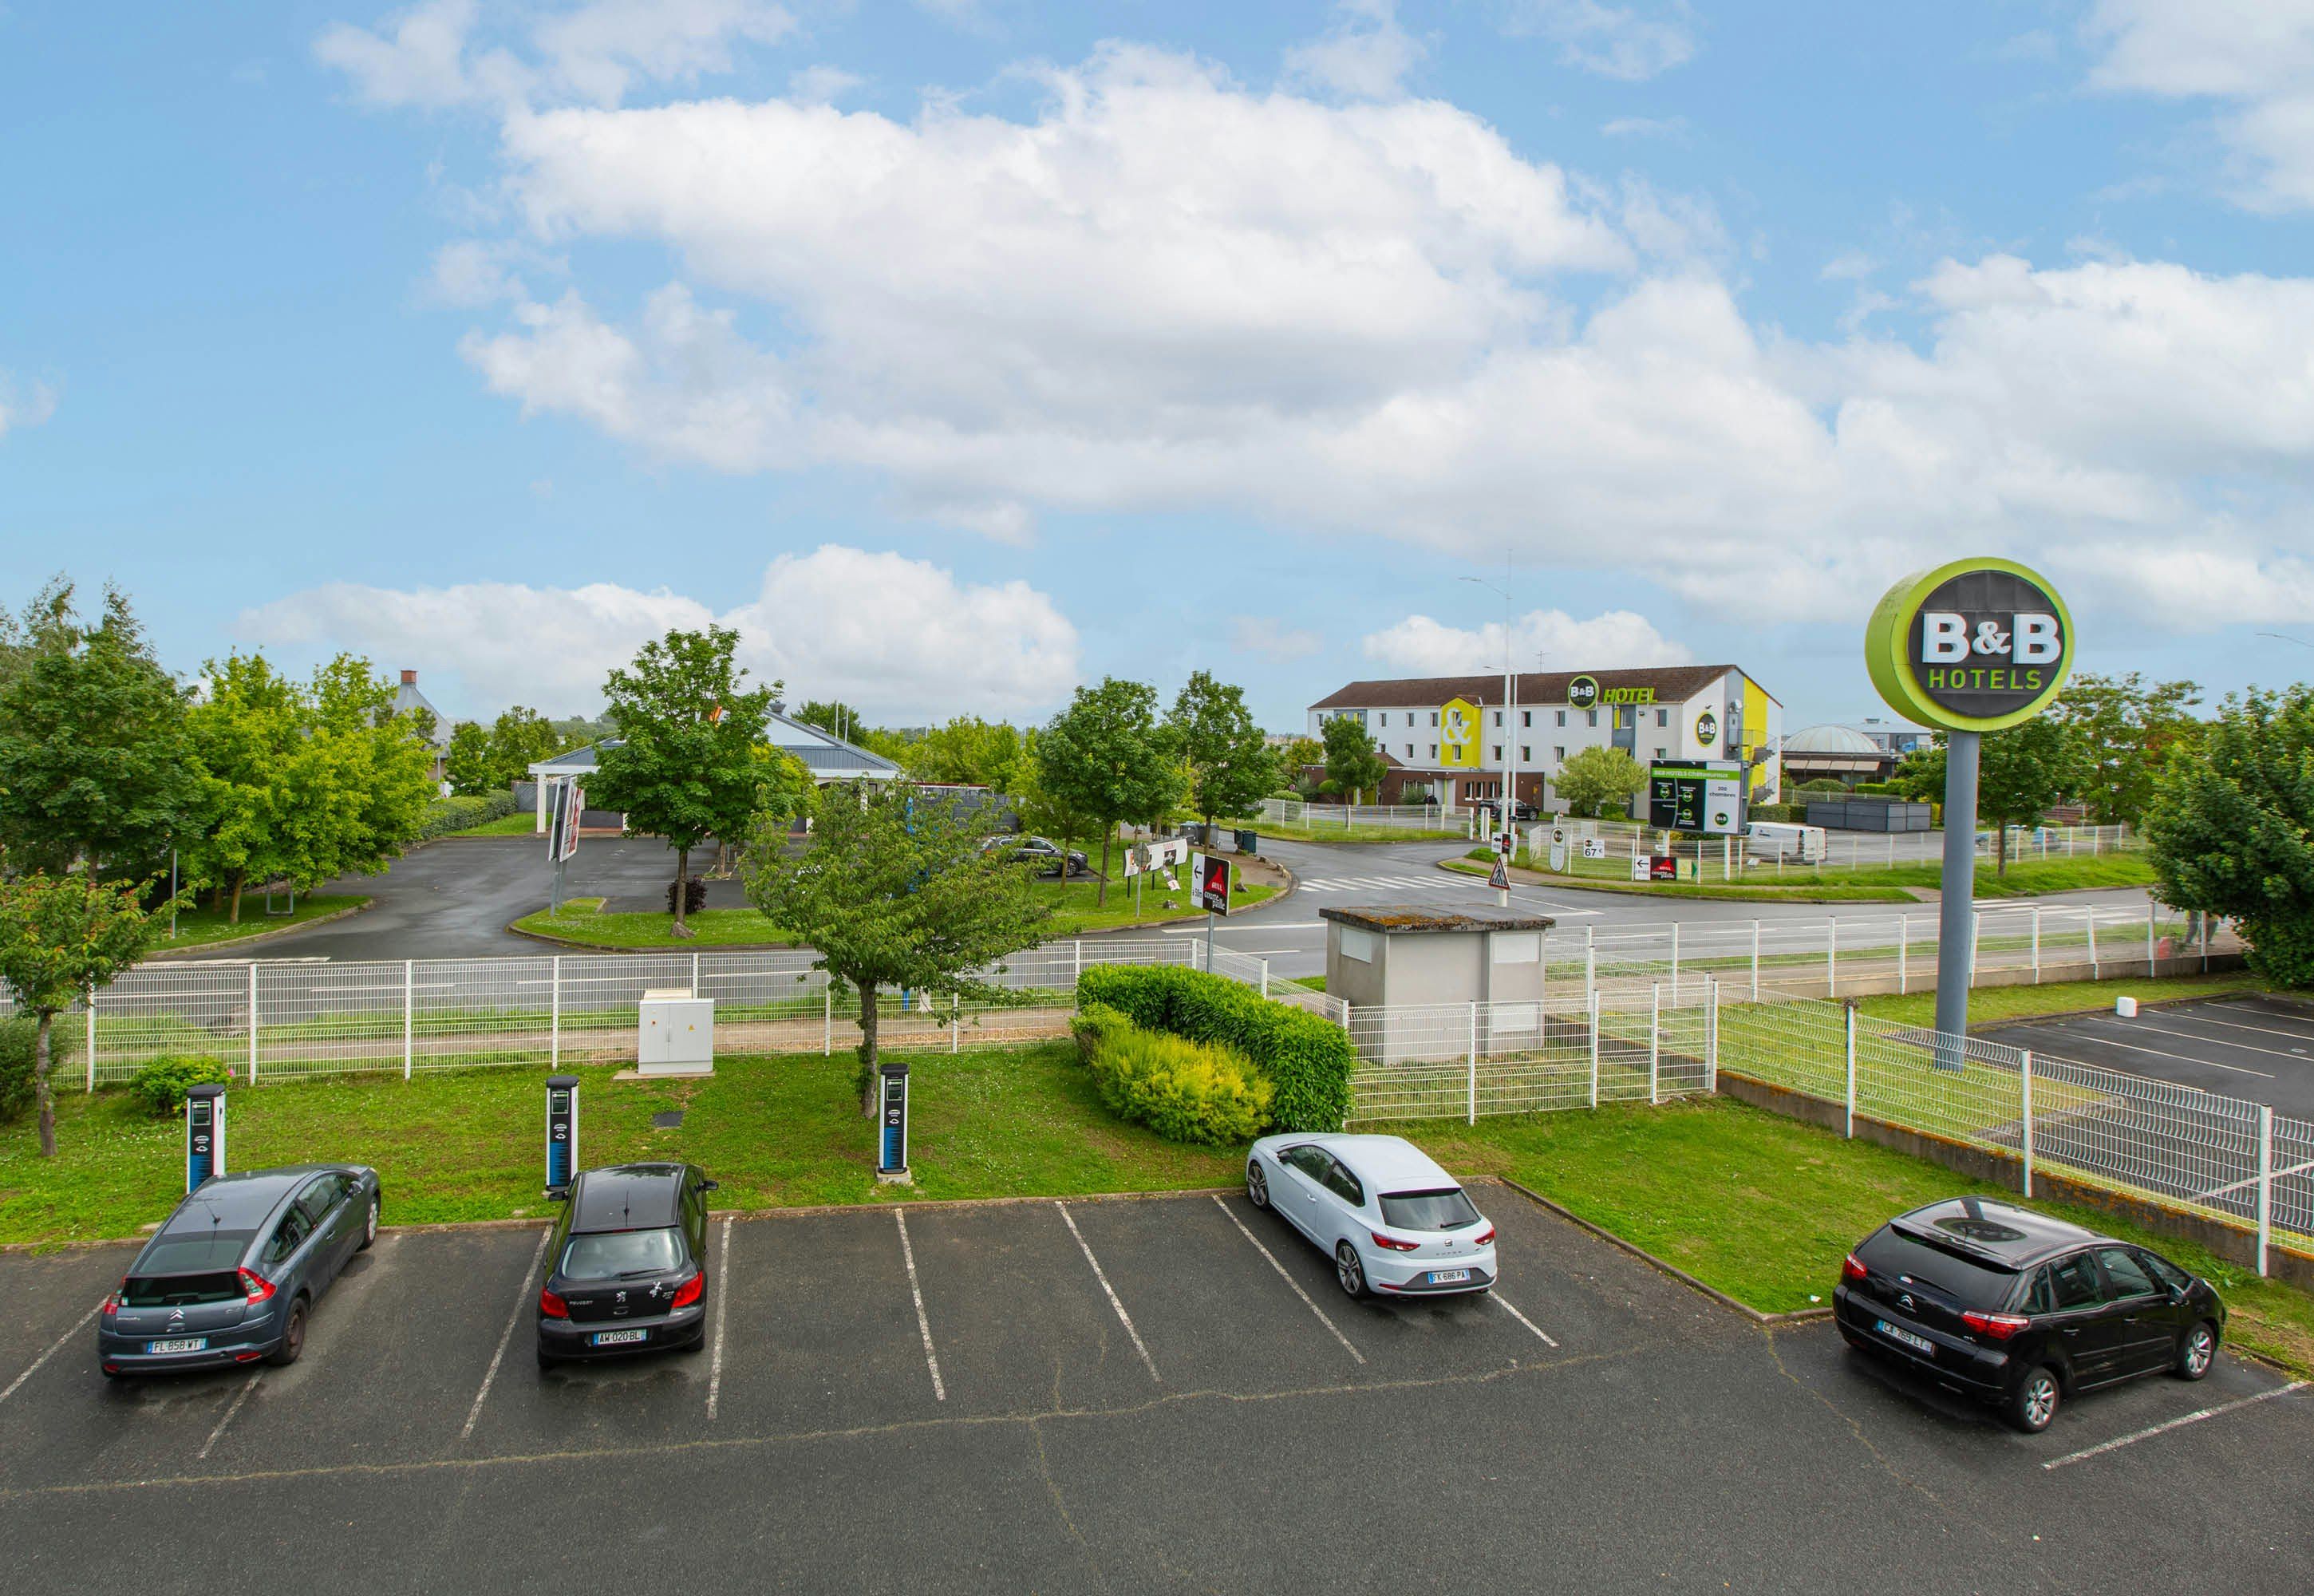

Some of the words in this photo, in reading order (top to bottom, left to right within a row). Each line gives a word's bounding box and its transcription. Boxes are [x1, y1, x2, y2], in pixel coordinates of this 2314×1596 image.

[1922, 613, 2062, 664] B&B
[1928, 669, 2042, 689] HOTELS
[1570, 686, 1594, 697] B&B
[1603, 688, 1658, 703] HOTEL
[1699, 722, 1716, 734] B&B
[1211, 881, 1222, 891] GRILL
[1204, 891, 1220, 902] courte
[1212, 898, 1226, 911] paille
